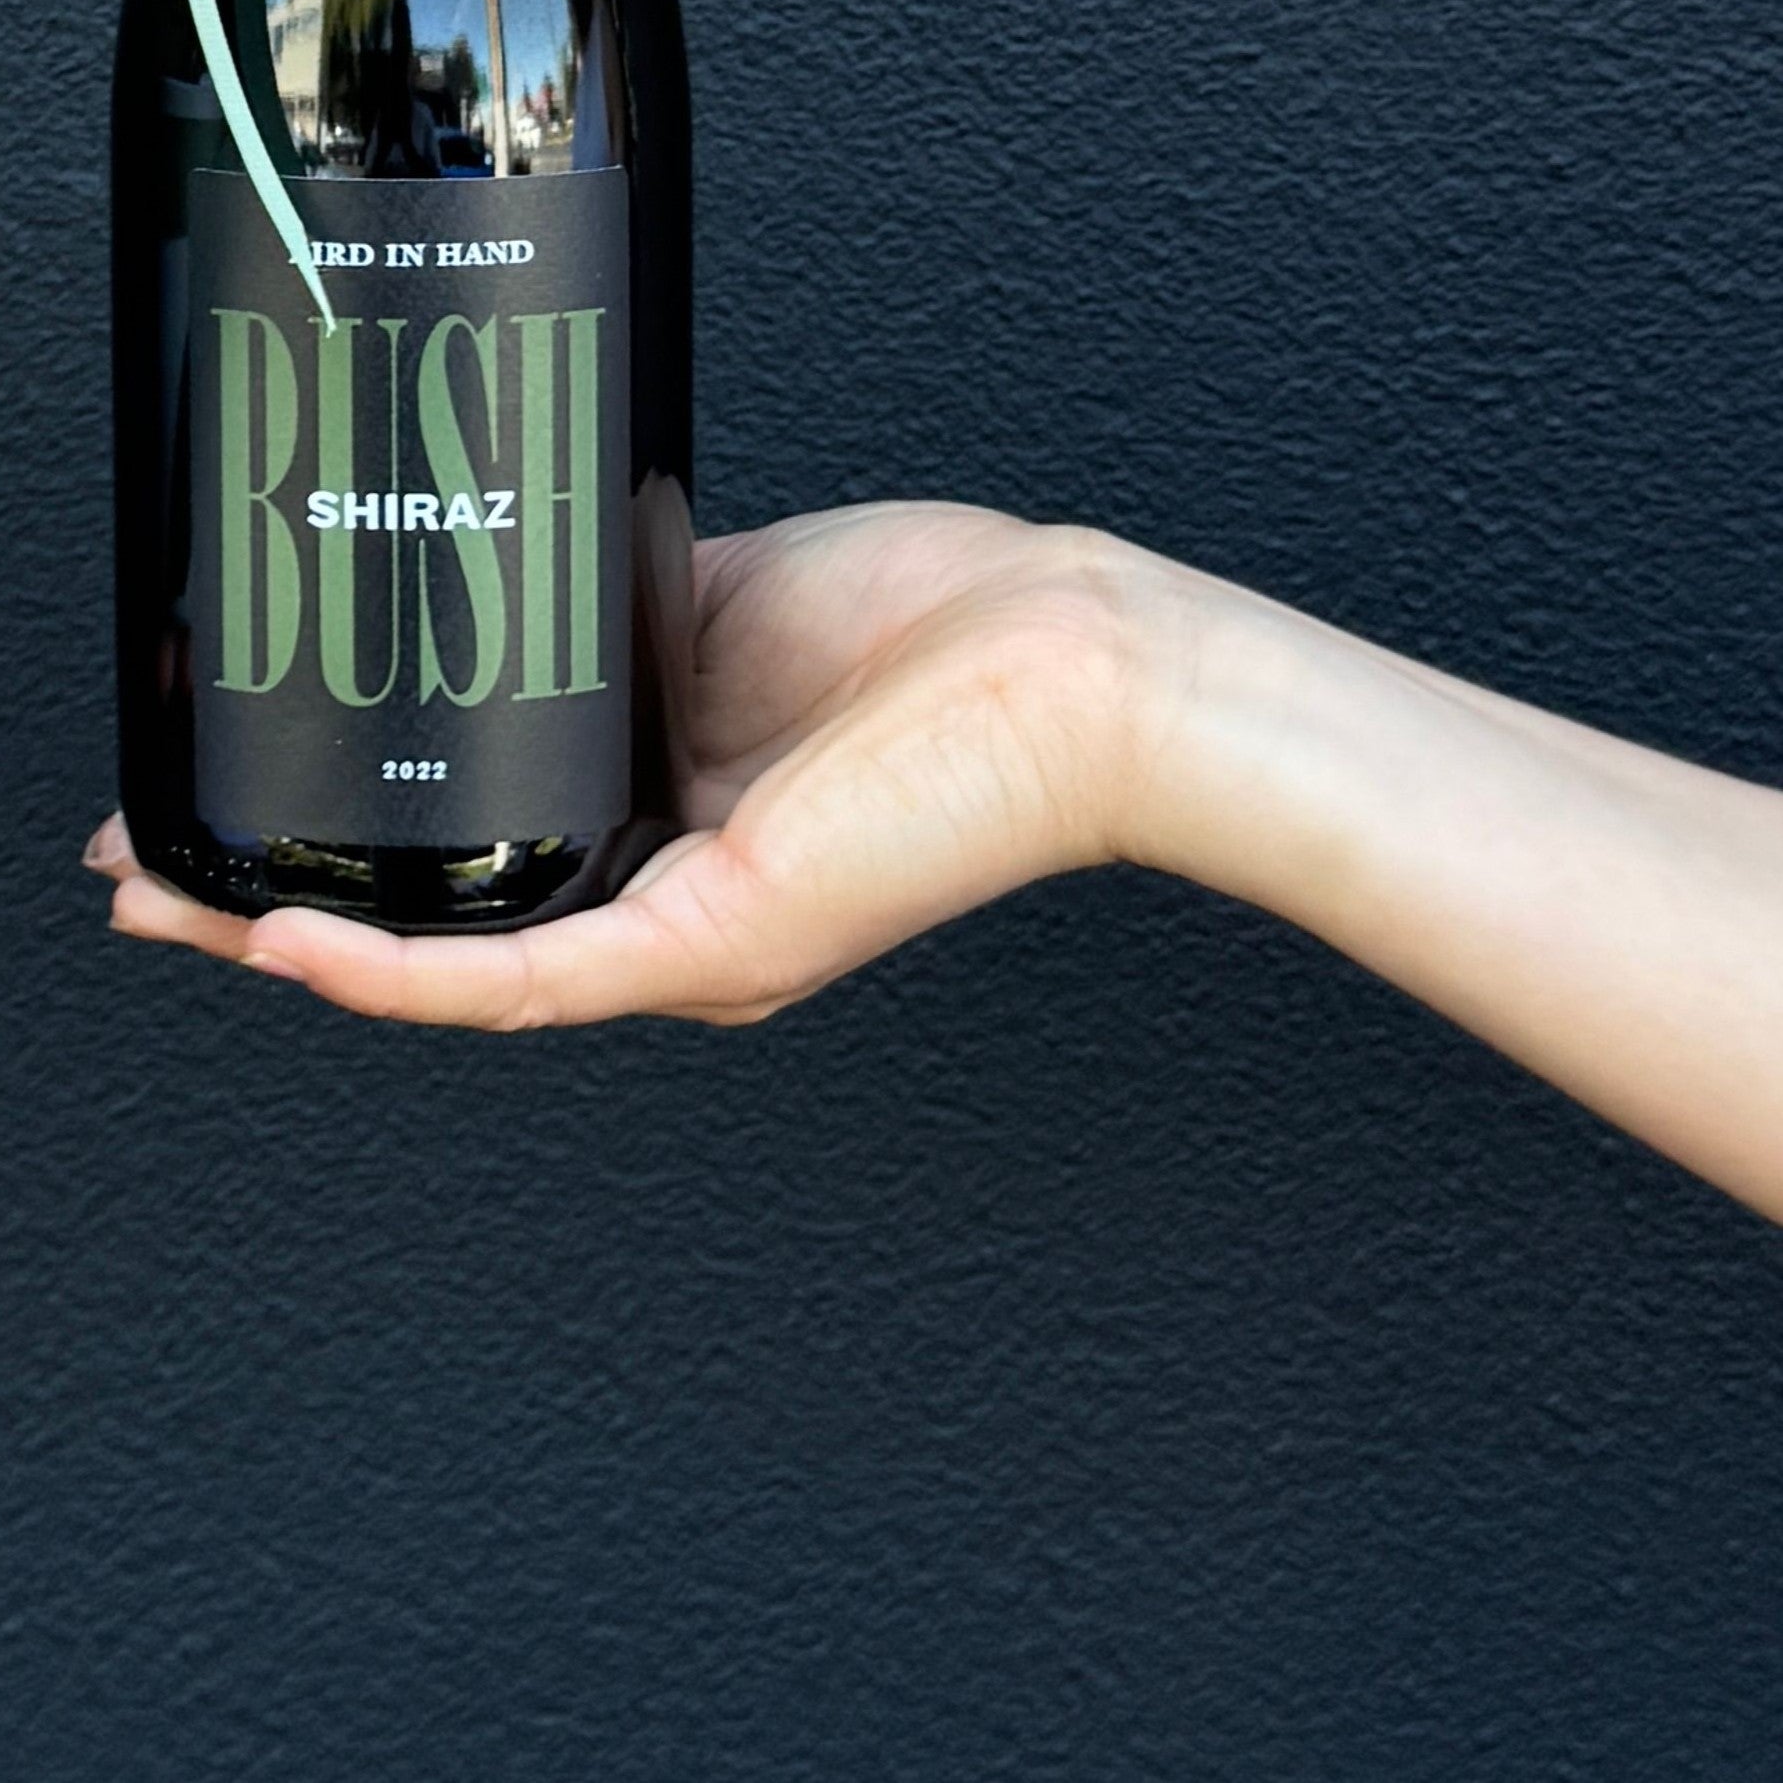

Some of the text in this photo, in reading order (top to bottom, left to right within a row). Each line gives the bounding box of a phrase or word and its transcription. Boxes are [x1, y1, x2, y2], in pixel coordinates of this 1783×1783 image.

[289, 239, 535, 267] IRD IN HAND
[210, 307, 607, 708] BUSH
[306, 491, 517, 532] SHIRAZ
[382, 760, 448, 781] 2022
